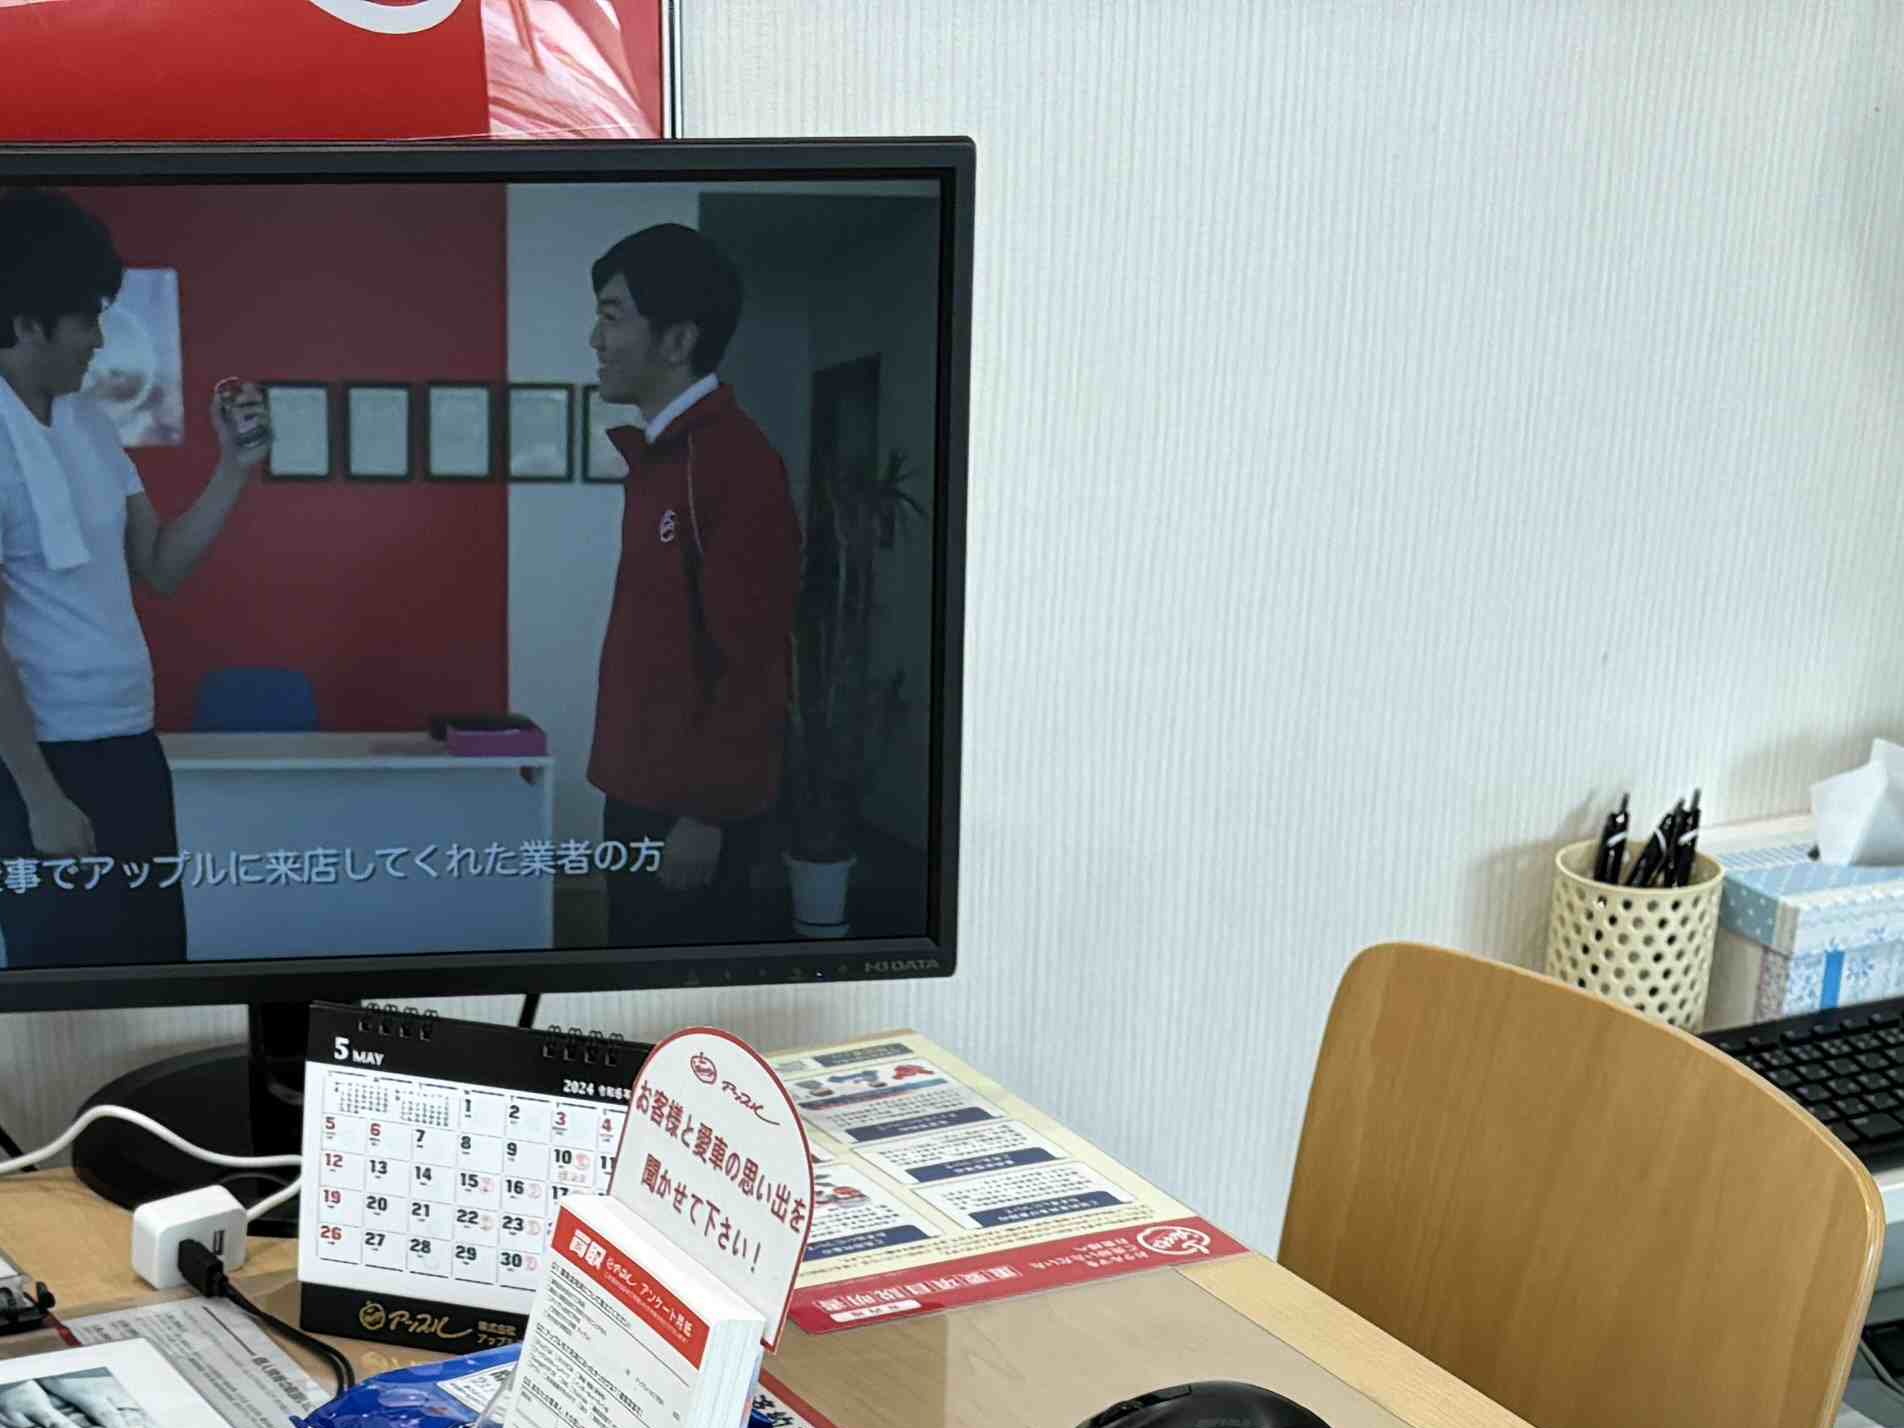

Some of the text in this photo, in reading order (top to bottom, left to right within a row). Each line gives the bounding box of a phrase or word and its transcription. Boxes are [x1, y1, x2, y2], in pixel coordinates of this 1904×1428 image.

[333, 1036, 384, 1066] 5 MAY
[562, 1079, 594, 1096] 2024
[465, 1098, 612, 1132] 1 2 3 4
[325, 1116, 615, 1171] 5 6 7 8 9 10 11
[635, 1079, 810, 1234] お客様と愛車の思い出を
[325, 1153, 342, 1168] 12
[370, 1159, 388, 1175] 13
[415, 1165, 432, 1181] 14
[460, 1172, 478, 1188] 15
[506, 1179, 524, 1195] 16
[324, 1189, 523, 1231] 19 20 21 22 23
[640, 1152, 763, 1275] 聞かせて下さい！
[320, 1225, 522, 1268] 26 27 28 29 30
[637, 1281, 694, 1339] アンケート用紙
